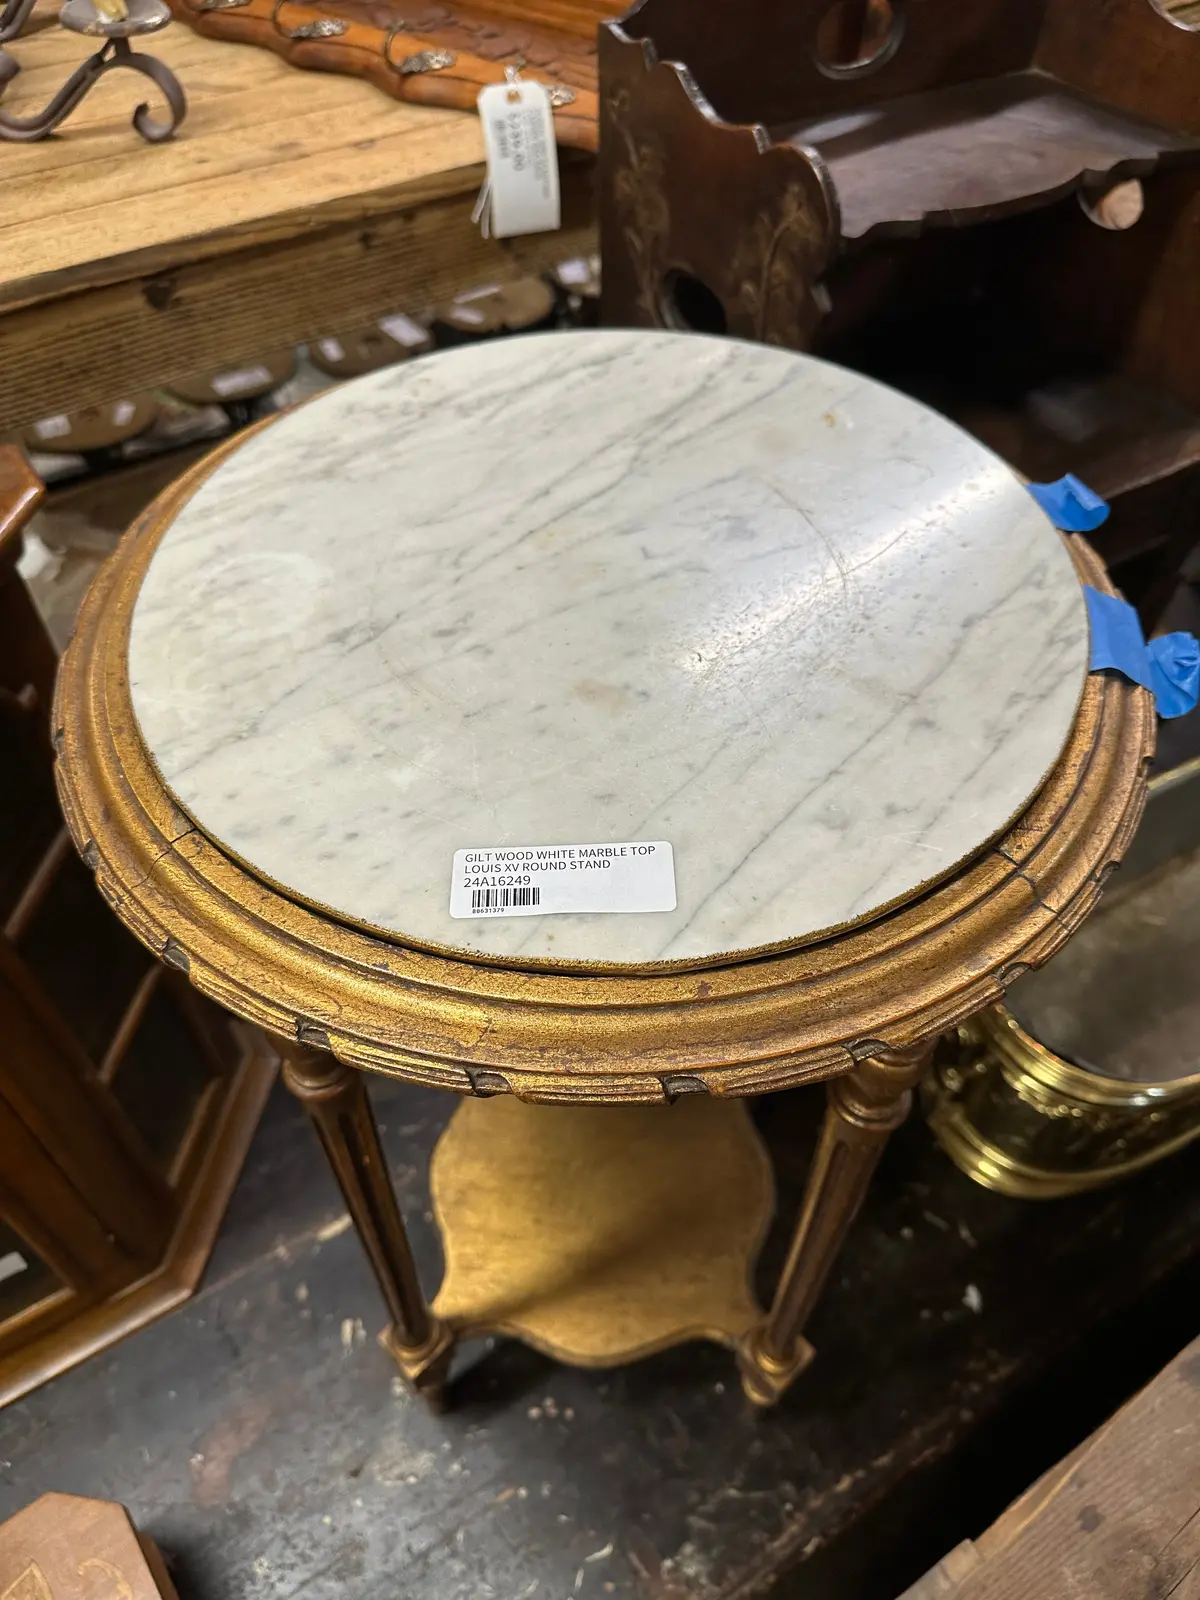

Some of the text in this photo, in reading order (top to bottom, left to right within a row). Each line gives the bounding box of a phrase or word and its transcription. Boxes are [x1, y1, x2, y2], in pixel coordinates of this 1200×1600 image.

[465, 845, 656, 863] GILT WOOD WHITE MARBLE TOP
[464, 859, 611, 874] LOUIS XV ROUND STAND
[463, 875, 531, 888] 24A16249
